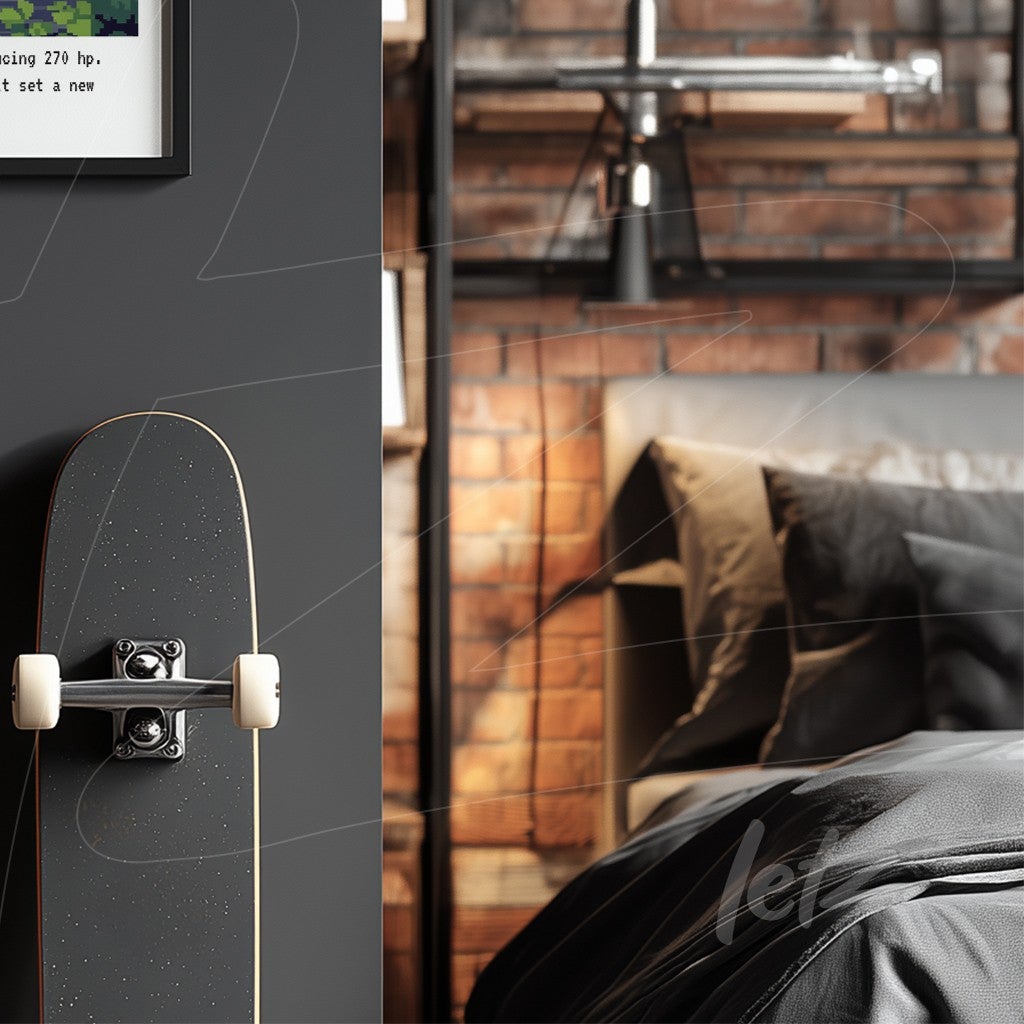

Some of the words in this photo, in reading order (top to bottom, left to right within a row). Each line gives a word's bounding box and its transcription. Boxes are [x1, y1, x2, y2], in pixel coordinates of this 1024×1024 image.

[44, 50, 69, 65] 270
[77, 50, 101, 68] hp.
[19, 78, 44, 92] set
[52, 81, 61, 92] a
[69, 81, 95, 92] new
